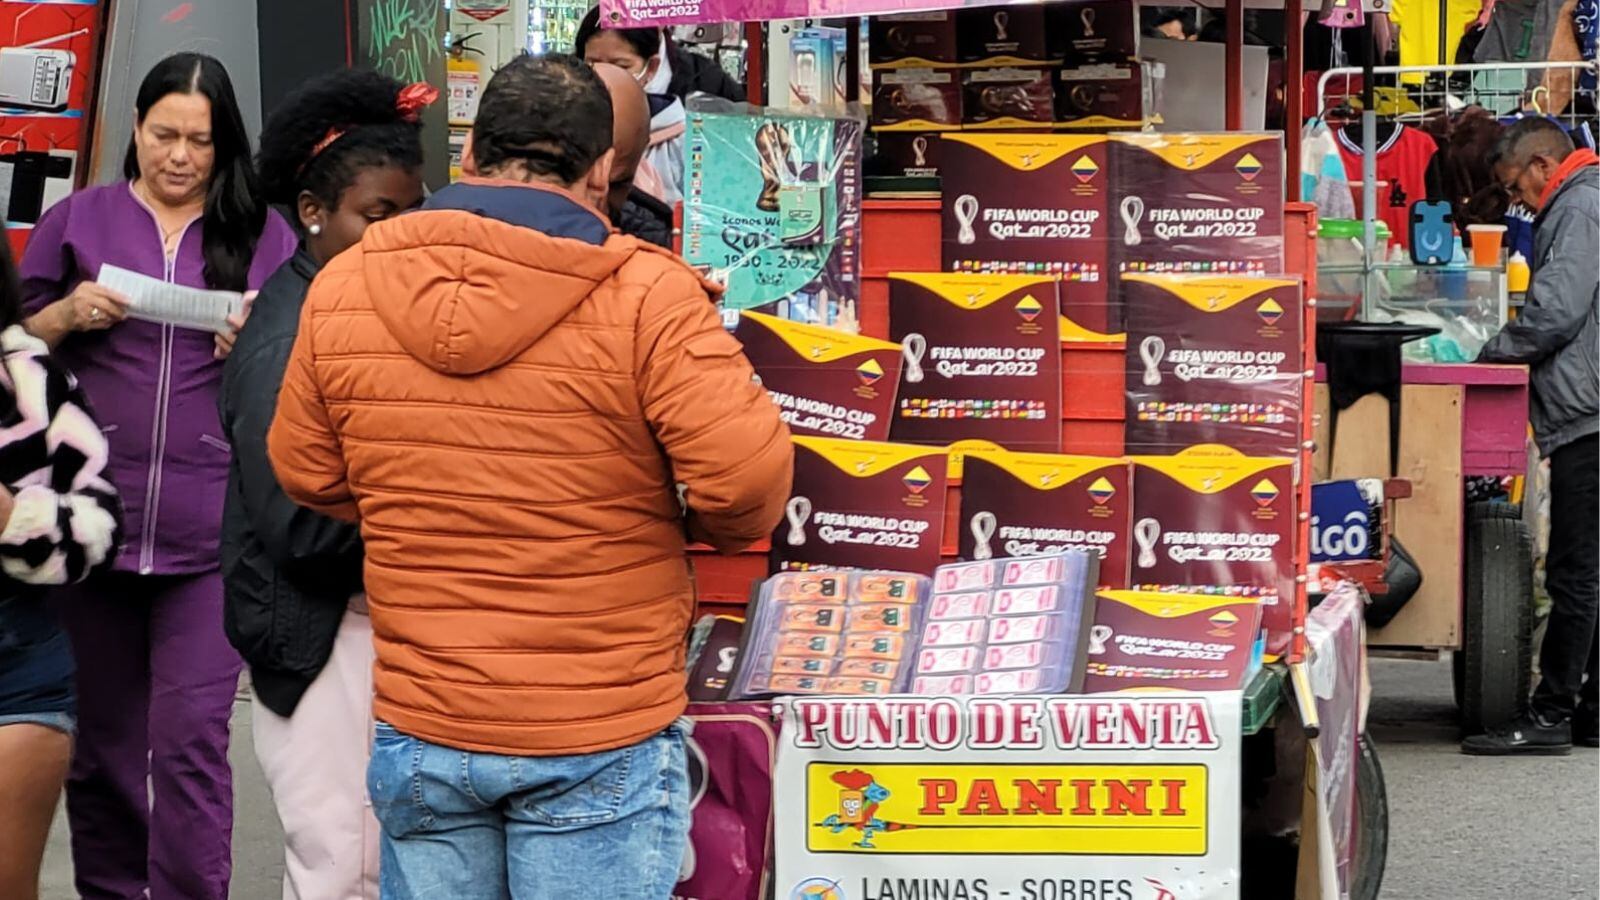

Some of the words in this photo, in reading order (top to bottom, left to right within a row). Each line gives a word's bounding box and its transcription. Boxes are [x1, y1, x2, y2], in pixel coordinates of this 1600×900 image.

[983, 208, 1014, 221] FIFA
[1016, 209, 1068, 222] WORLD
[1070, 210, 1099, 222] CUP
[1149, 209, 1180, 222] FIFA
[1182, 208, 1234, 222] WORLD
[1235, 207, 1264, 221] CUP
[930, 347, 962, 360] FIFA
[964, 347, 1015, 360] WORLD
[1016, 348, 1046, 360] CUP
[1168, 349, 1201, 362] FIFA
[1202, 350, 1254, 364] WORLD
[1255, 351, 1286, 364] CUP
[795, 397, 845, 419] WORLD
[846, 409, 876, 425] CUP
[779, 410, 865, 440] atar2022
[814, 511, 846, 526] FIFA
[847, 514, 898, 531] WORLD
[899, 519, 929, 533] CUP
[999, 526, 1032, 540] FIFA
[1033, 527, 1085, 542] WORLD
[1086, 530, 1116, 544] CUP
[1163, 531, 1195, 545] FIFA
[1195, 532, 1249, 546] WORLD
[1250, 533, 1280, 547] CUP
[799, 701, 959, 745] PUNTO
[973, 702, 1039, 745] DE
[1053, 702, 1215, 745] VENTA
[918, 778, 1187, 817] PANINI
[861, 876, 989, 900] LAMINAS
[1020, 878, 1133, 900] SOBRES
